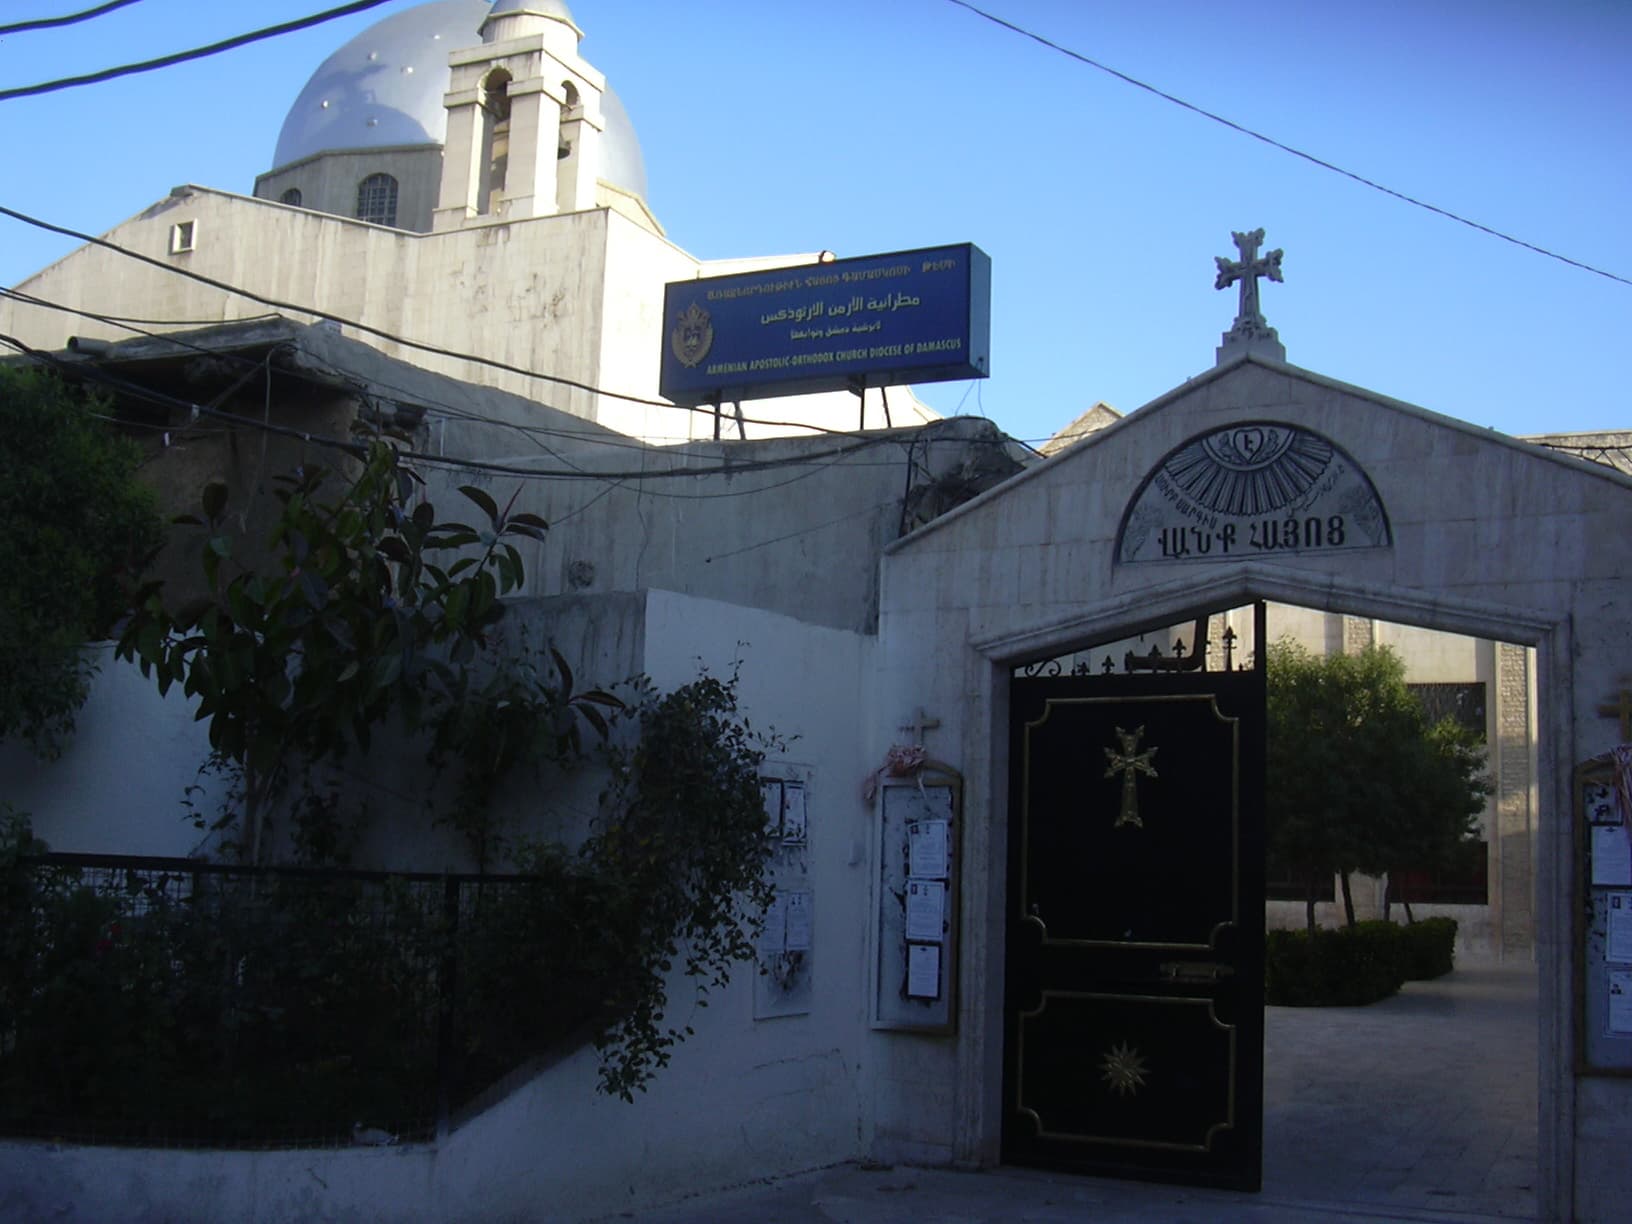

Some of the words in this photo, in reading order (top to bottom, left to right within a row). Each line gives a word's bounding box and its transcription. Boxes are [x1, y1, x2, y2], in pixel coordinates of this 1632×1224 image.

[706, 361, 748, 375] ARMENIAN
[836, 347, 869, 362] CHURCH
[869, 343, 903, 359] DIOCESE
[903, 342, 915, 355] OF
[916, 337, 962, 353] DAMASCUS
[1157, 522, 1237, 559] ՎԱՆՔ
[1249, 515, 1346, 550] ՀԱՅՈՑ
